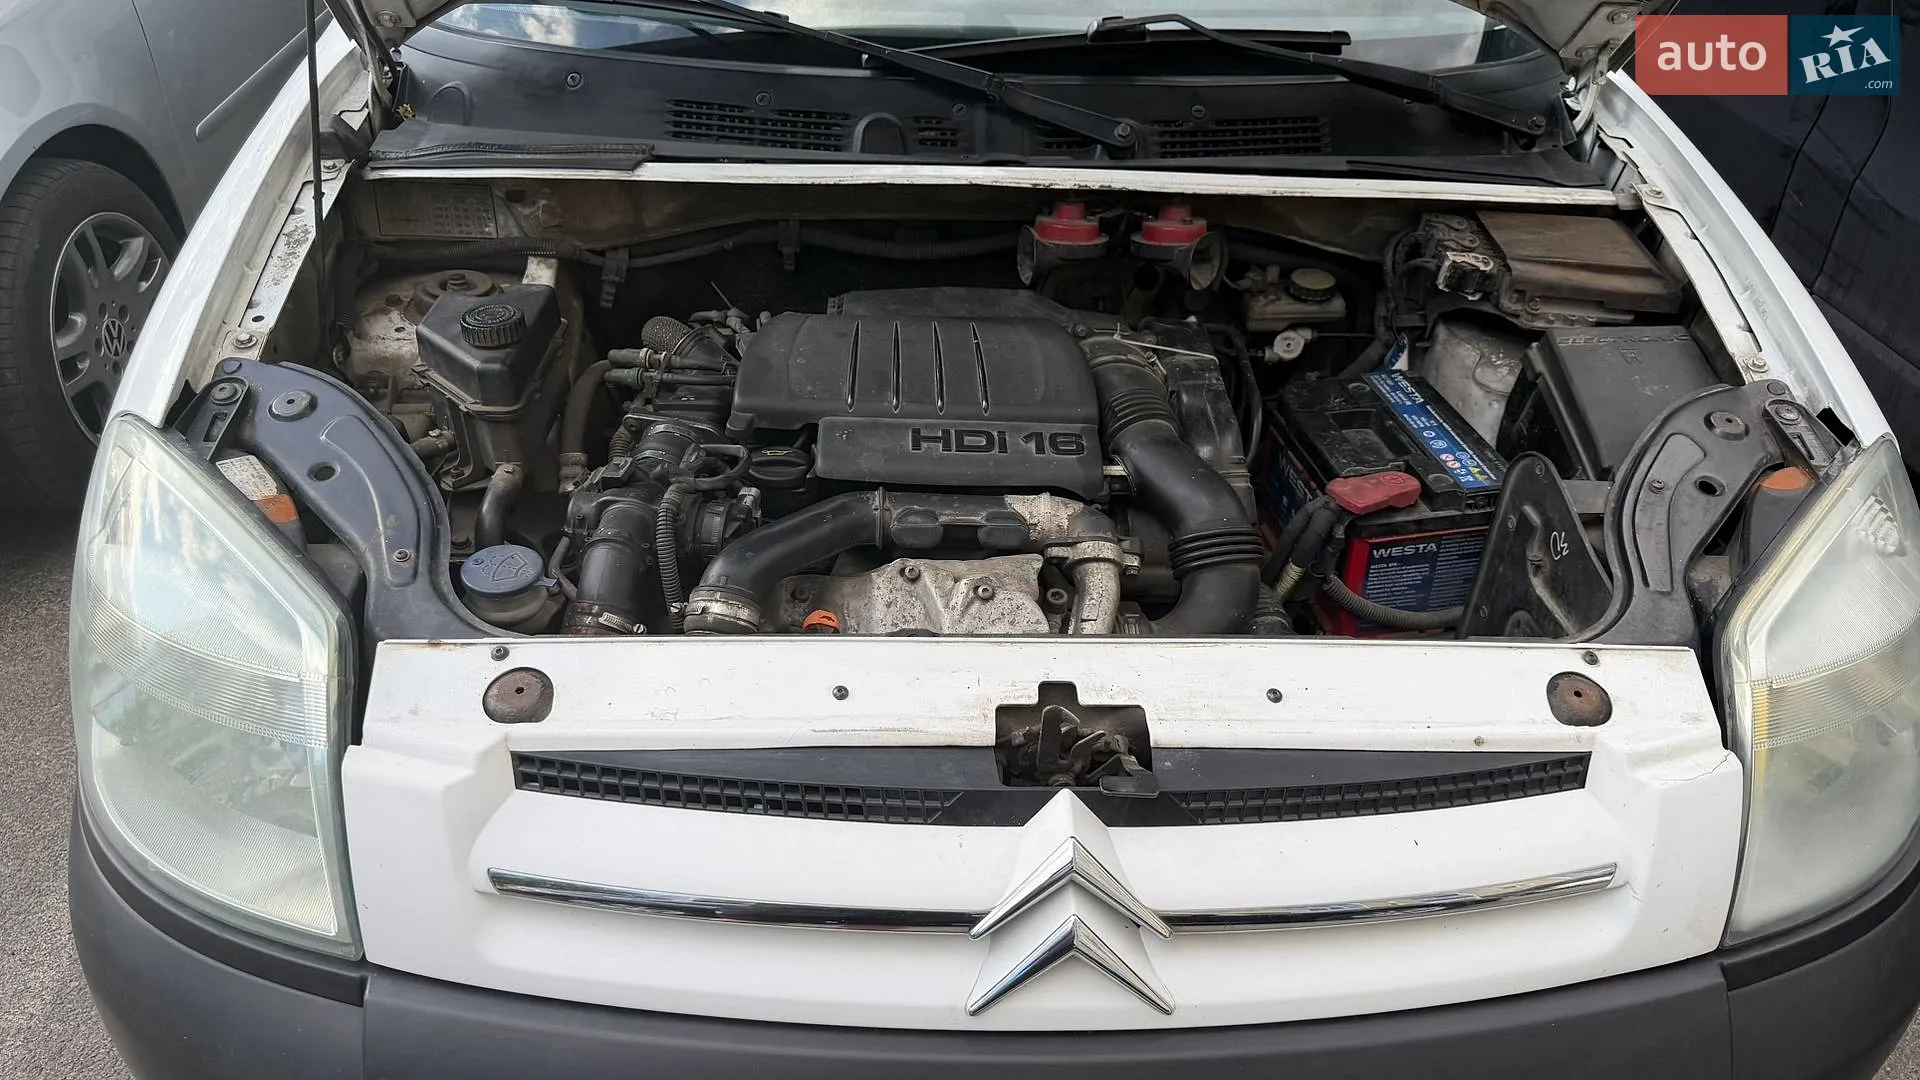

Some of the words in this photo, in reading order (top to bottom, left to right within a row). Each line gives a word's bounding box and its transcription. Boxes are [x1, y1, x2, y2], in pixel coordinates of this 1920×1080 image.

[102, 318, 127, 359] VW
[1391, 372, 1425, 405] WESTA
[910, 427, 1010, 454] HDi
[1020, 431, 1087, 457] 16
[1278, 451, 1314, 503] WEST
[1372, 542, 1438, 559] WESTA
